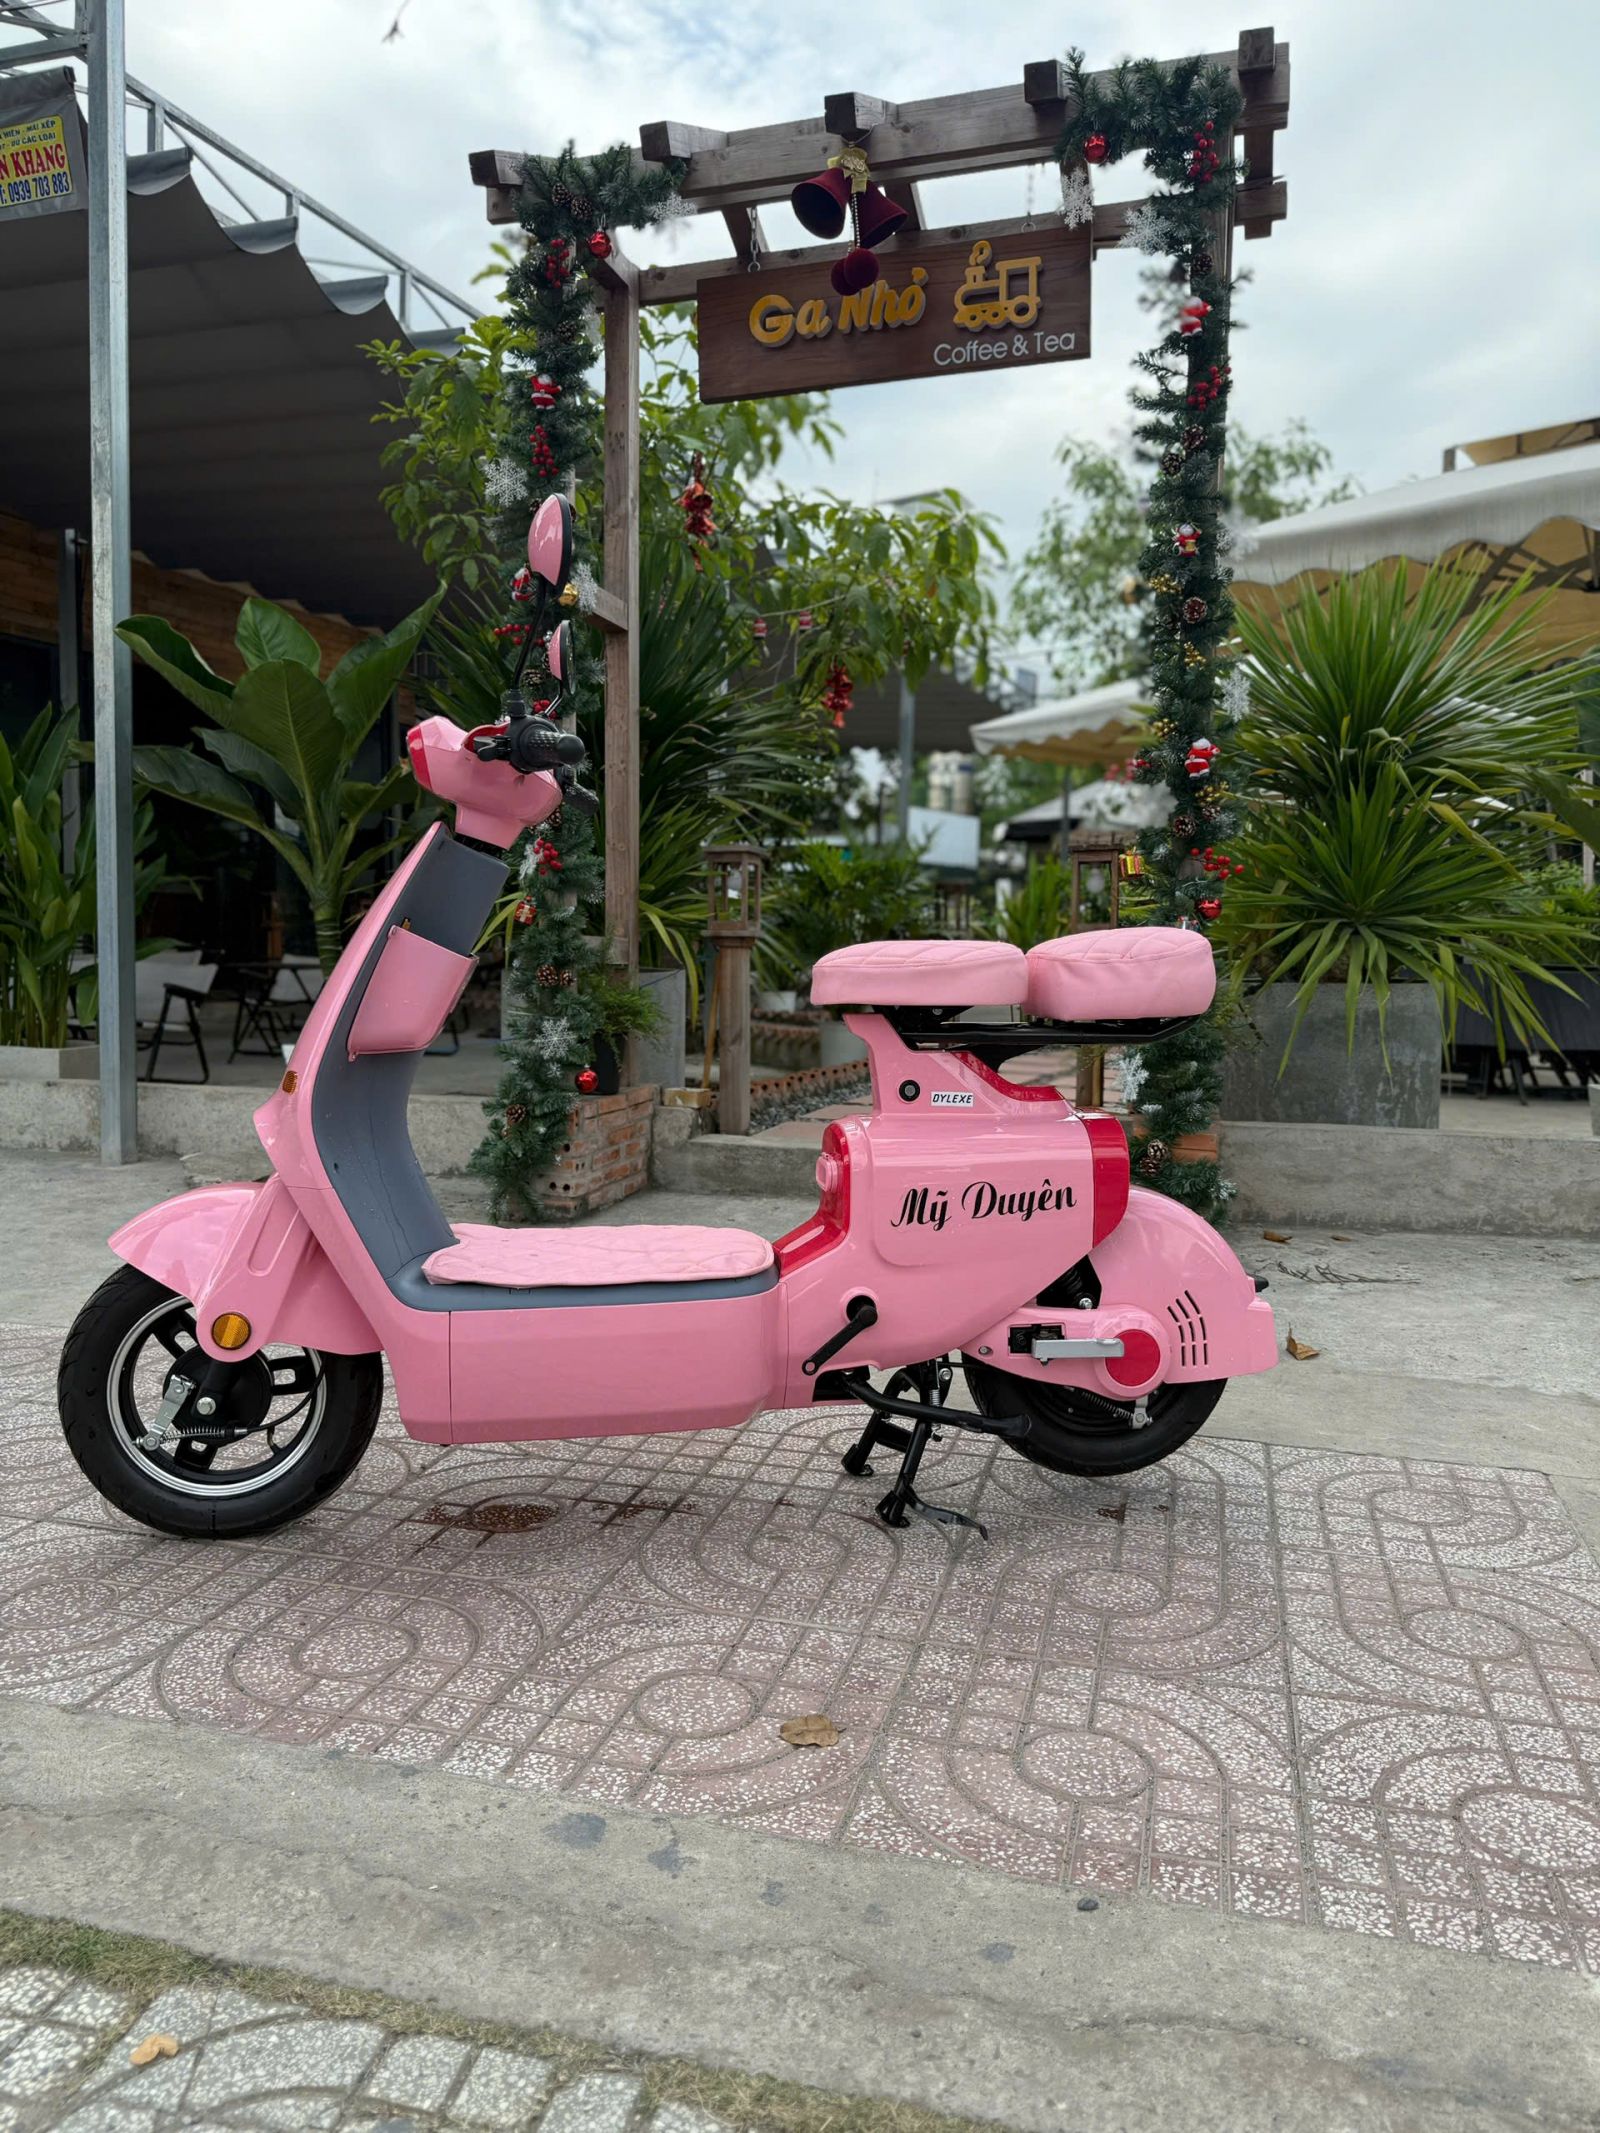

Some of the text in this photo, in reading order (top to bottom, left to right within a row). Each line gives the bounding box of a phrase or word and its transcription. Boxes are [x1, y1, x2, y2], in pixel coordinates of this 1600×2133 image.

[10, 143, 66, 177] KHANG
[8, 179, 32, 203] 0939
[32, 175, 51, 198] 703
[52, 171, 70, 194] 883
[749, 266, 929, 348] Ga Nhỏ
[933, 331, 1076, 366] Coffee & Tea
[932, 1092, 974, 1105] DYLEXE
[890, 1178, 1077, 1231] Mỹ Duyên
